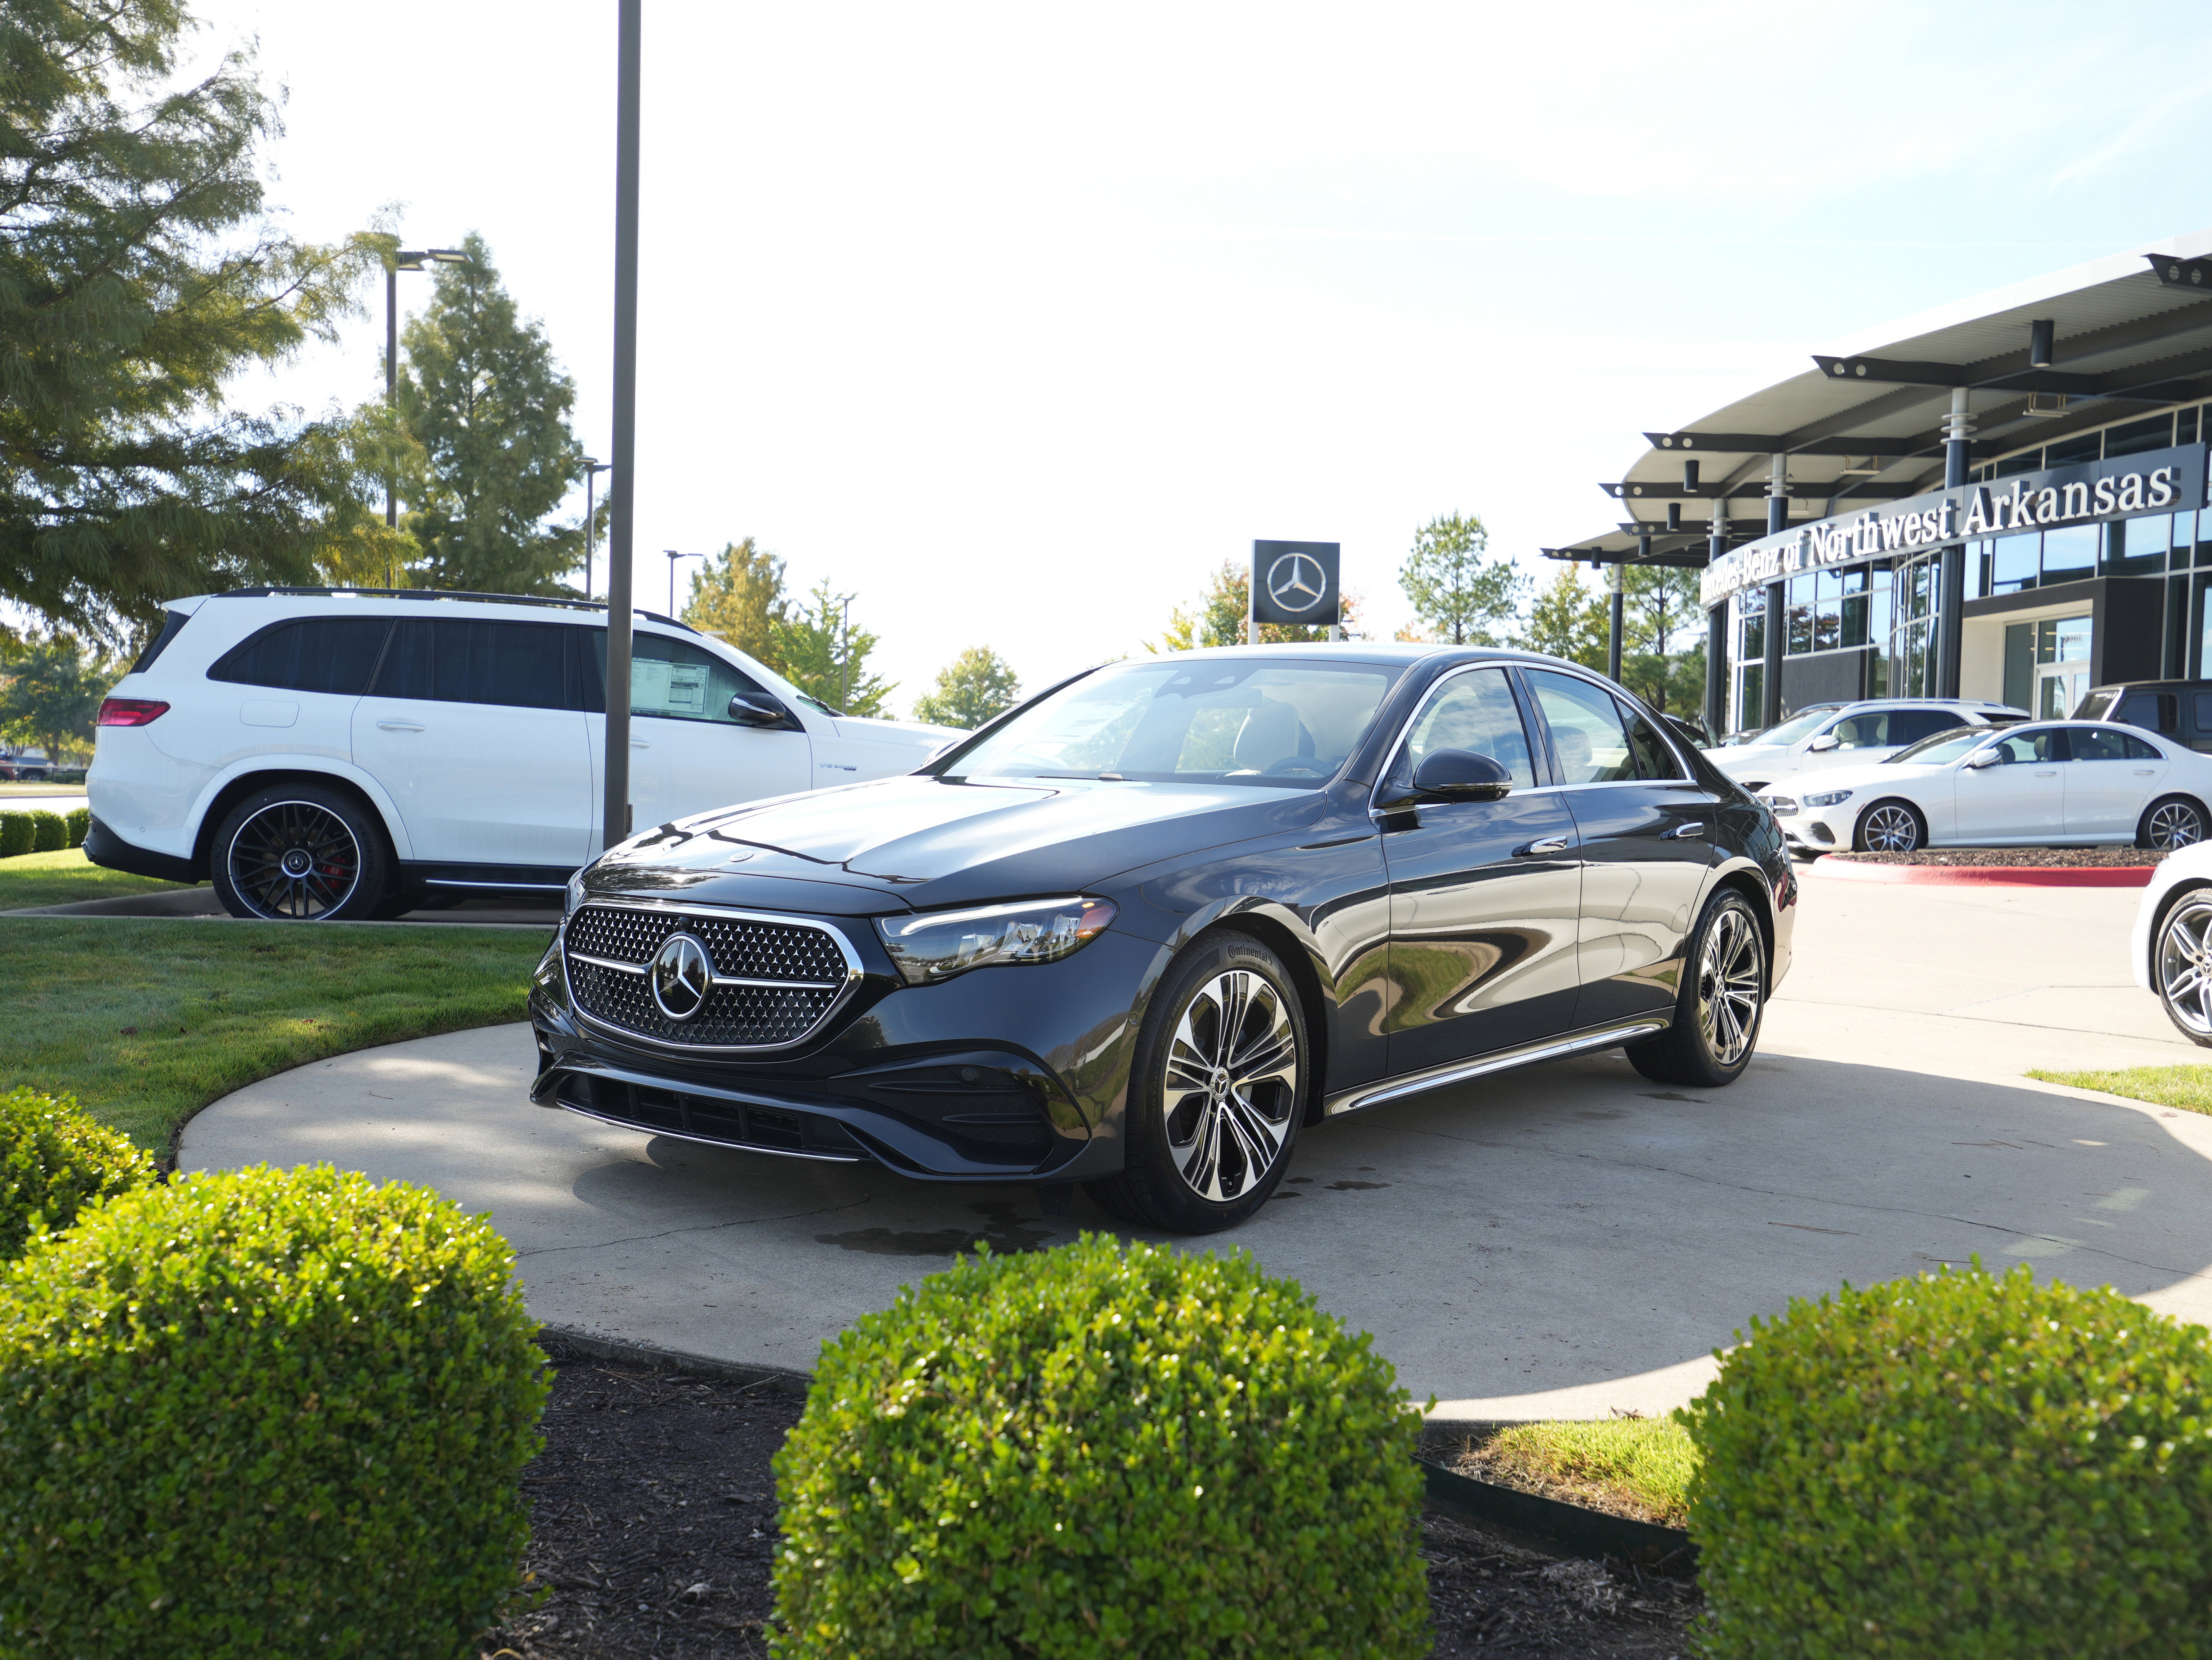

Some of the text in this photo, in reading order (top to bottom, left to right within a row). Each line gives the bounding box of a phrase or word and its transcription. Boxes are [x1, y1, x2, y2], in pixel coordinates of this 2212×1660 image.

[1783, 529, 1804, 572] of
[1808, 498, 1952, 567] Northwest
[1961, 466, 2171, 536] Arkansas
[1228, 945, 1268, 963] Continental
[1161, 1019, 1172, 1047] SSR
[1172, 991, 1186, 1018] MOE
